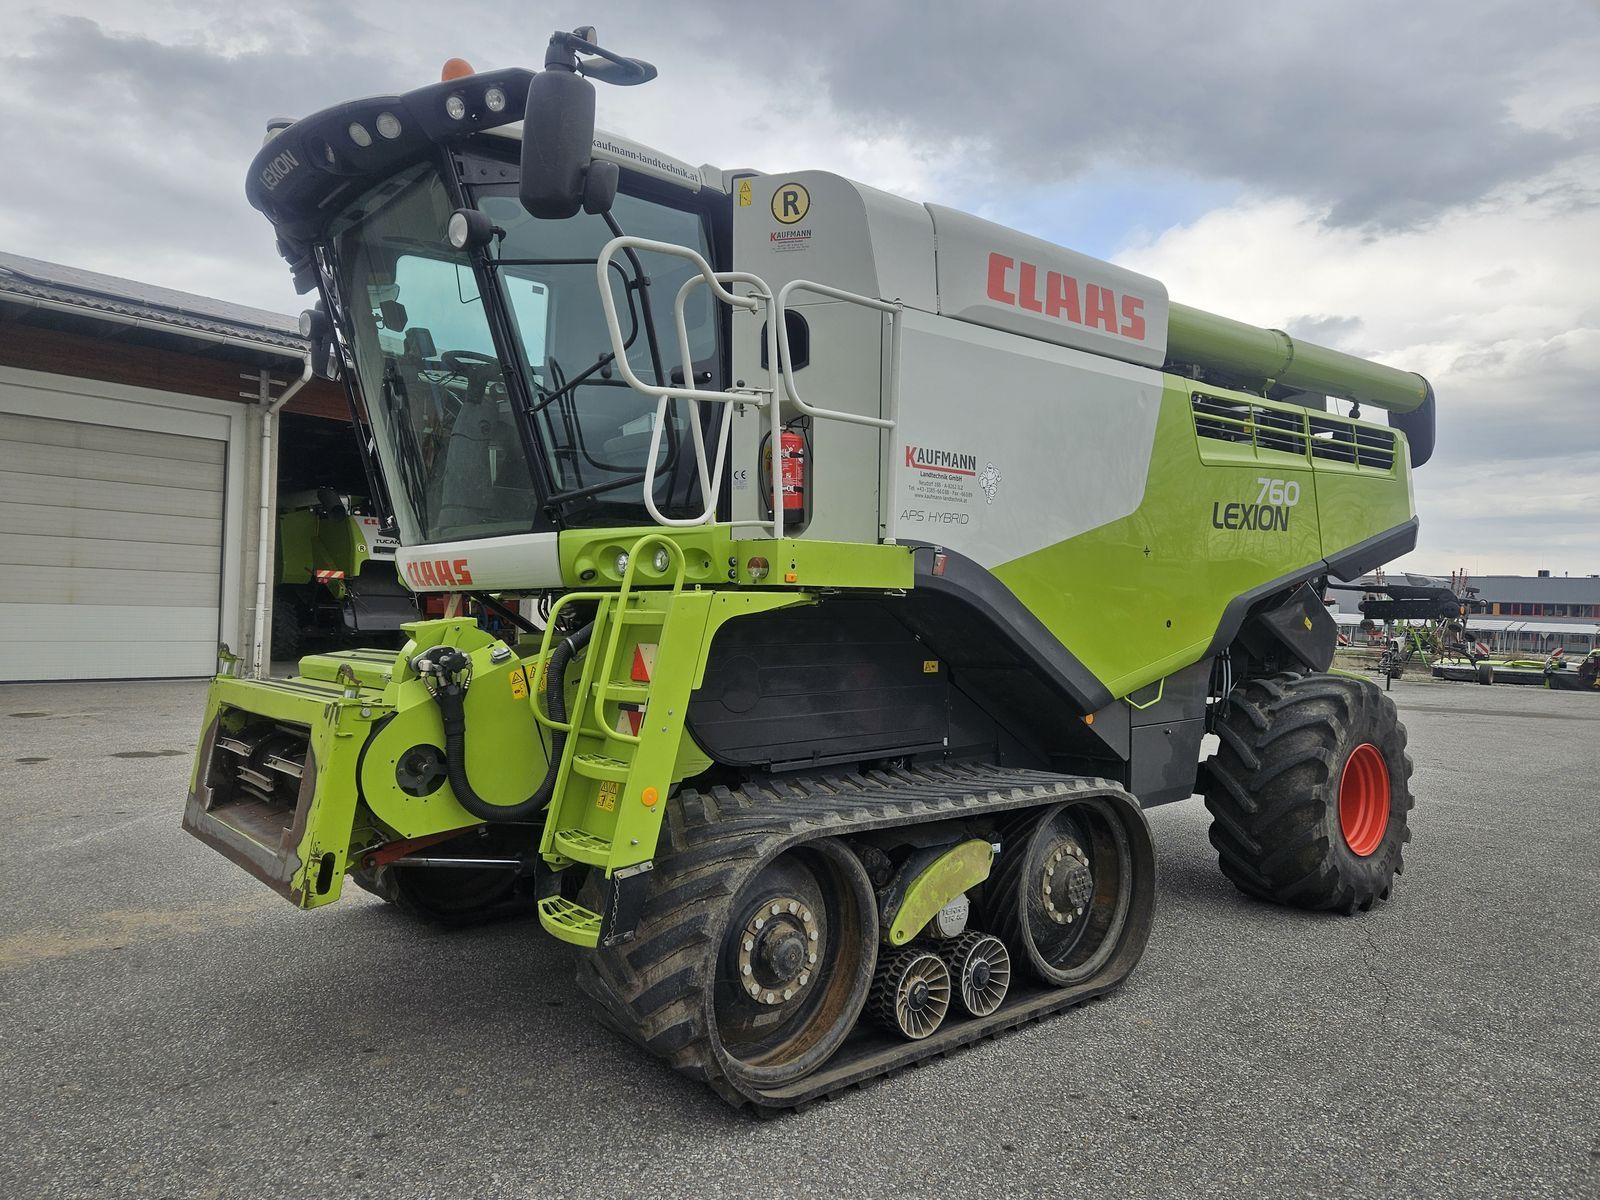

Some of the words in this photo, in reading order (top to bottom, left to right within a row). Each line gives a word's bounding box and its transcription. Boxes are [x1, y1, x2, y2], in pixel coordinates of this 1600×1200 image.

[259, 149, 299, 190] LEXION
[783, 191, 800, 217] R
[770, 229, 812, 242] KAUFMANN
[987, 252, 1146, 341] CLAAS
[905, 445, 976, 471] KAUFMANN
[920, 471, 948, 480] Landtechnik
[949, 474, 963, 482] GmbH
[1255, 477, 1300, 507] 760
[900, 509, 925, 522] APS
[928, 511, 970, 525] HYBRID
[1212, 501, 1290, 532] LEXION
[406, 559, 473, 587] CLAAS
